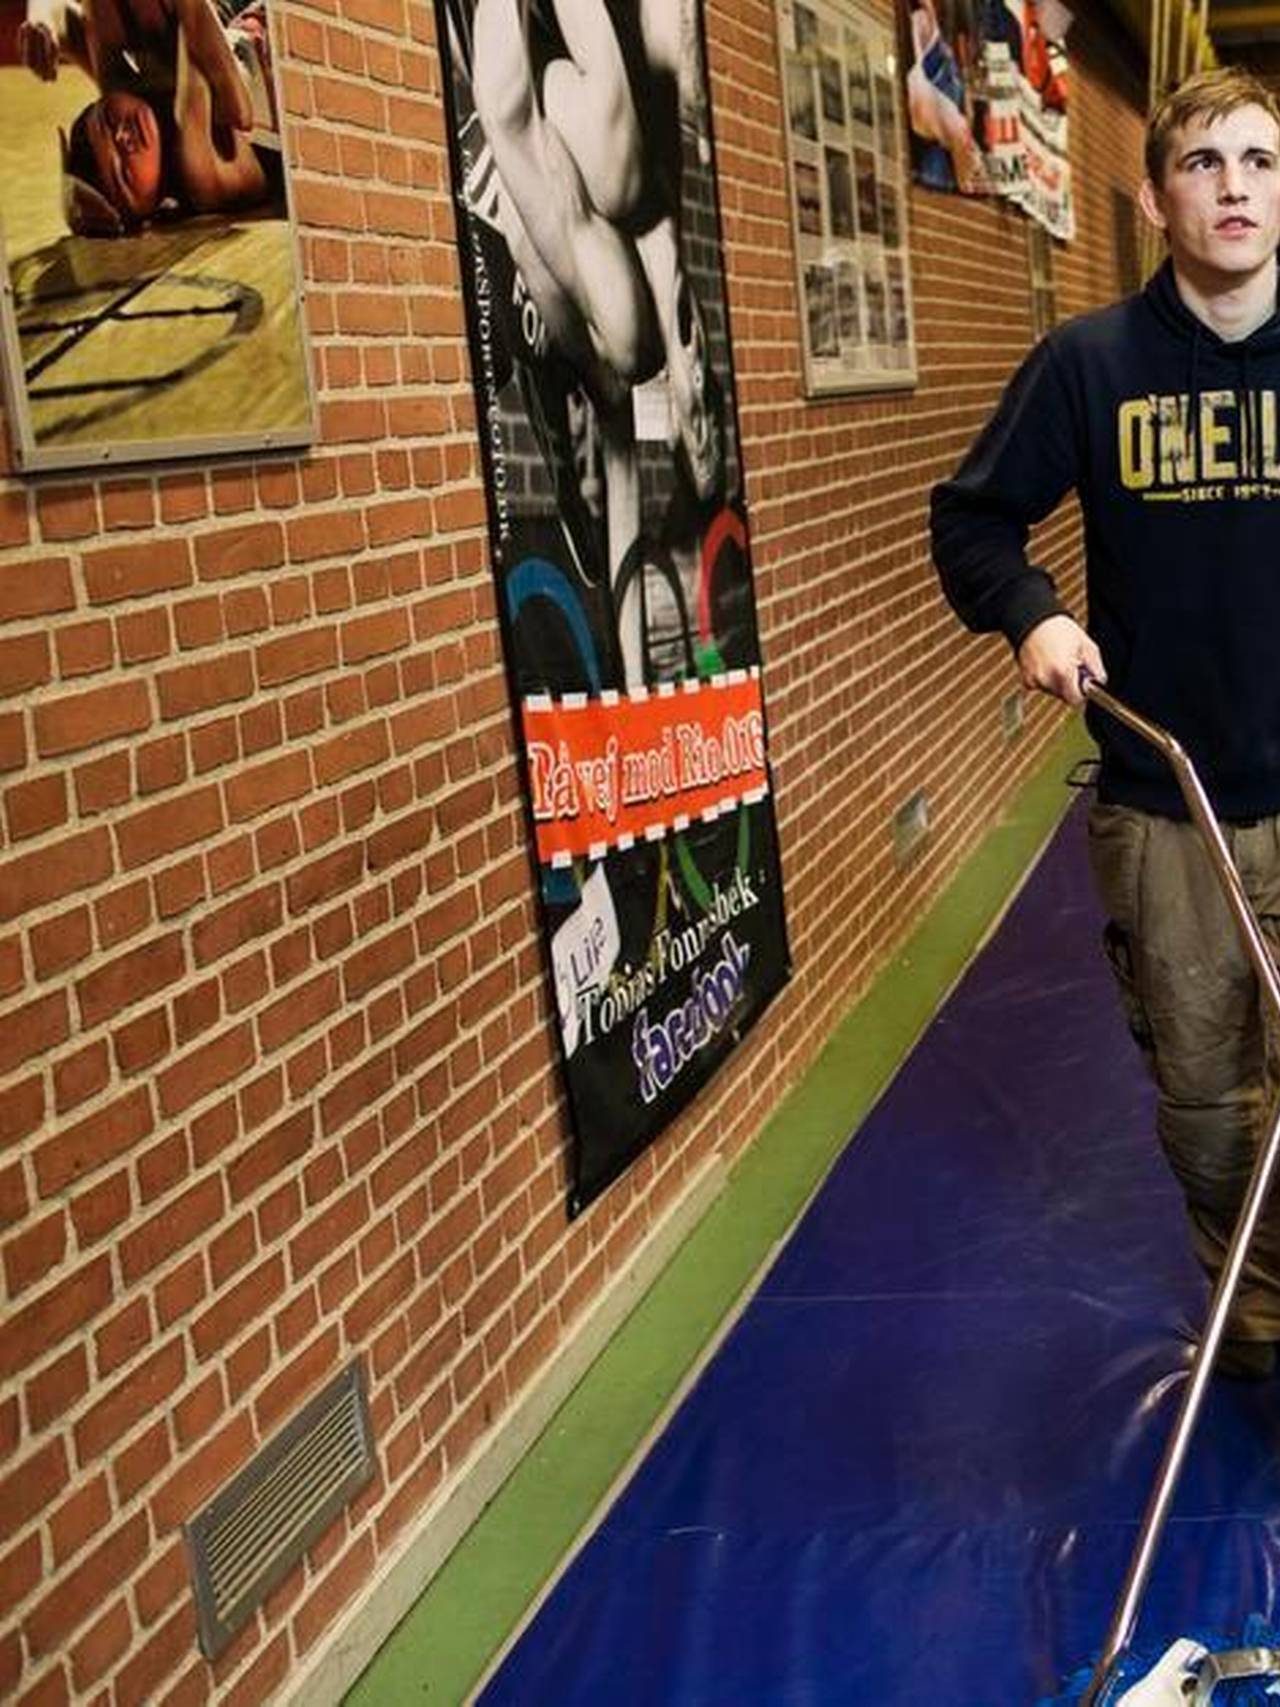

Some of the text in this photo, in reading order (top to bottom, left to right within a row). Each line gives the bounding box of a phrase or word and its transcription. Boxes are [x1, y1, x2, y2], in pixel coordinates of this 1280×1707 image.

[528, 740, 579, 819] På
[575, 735, 618, 822] vej
[623, 726, 677, 803] mod
[632, 931, 750, 1103] facebook
